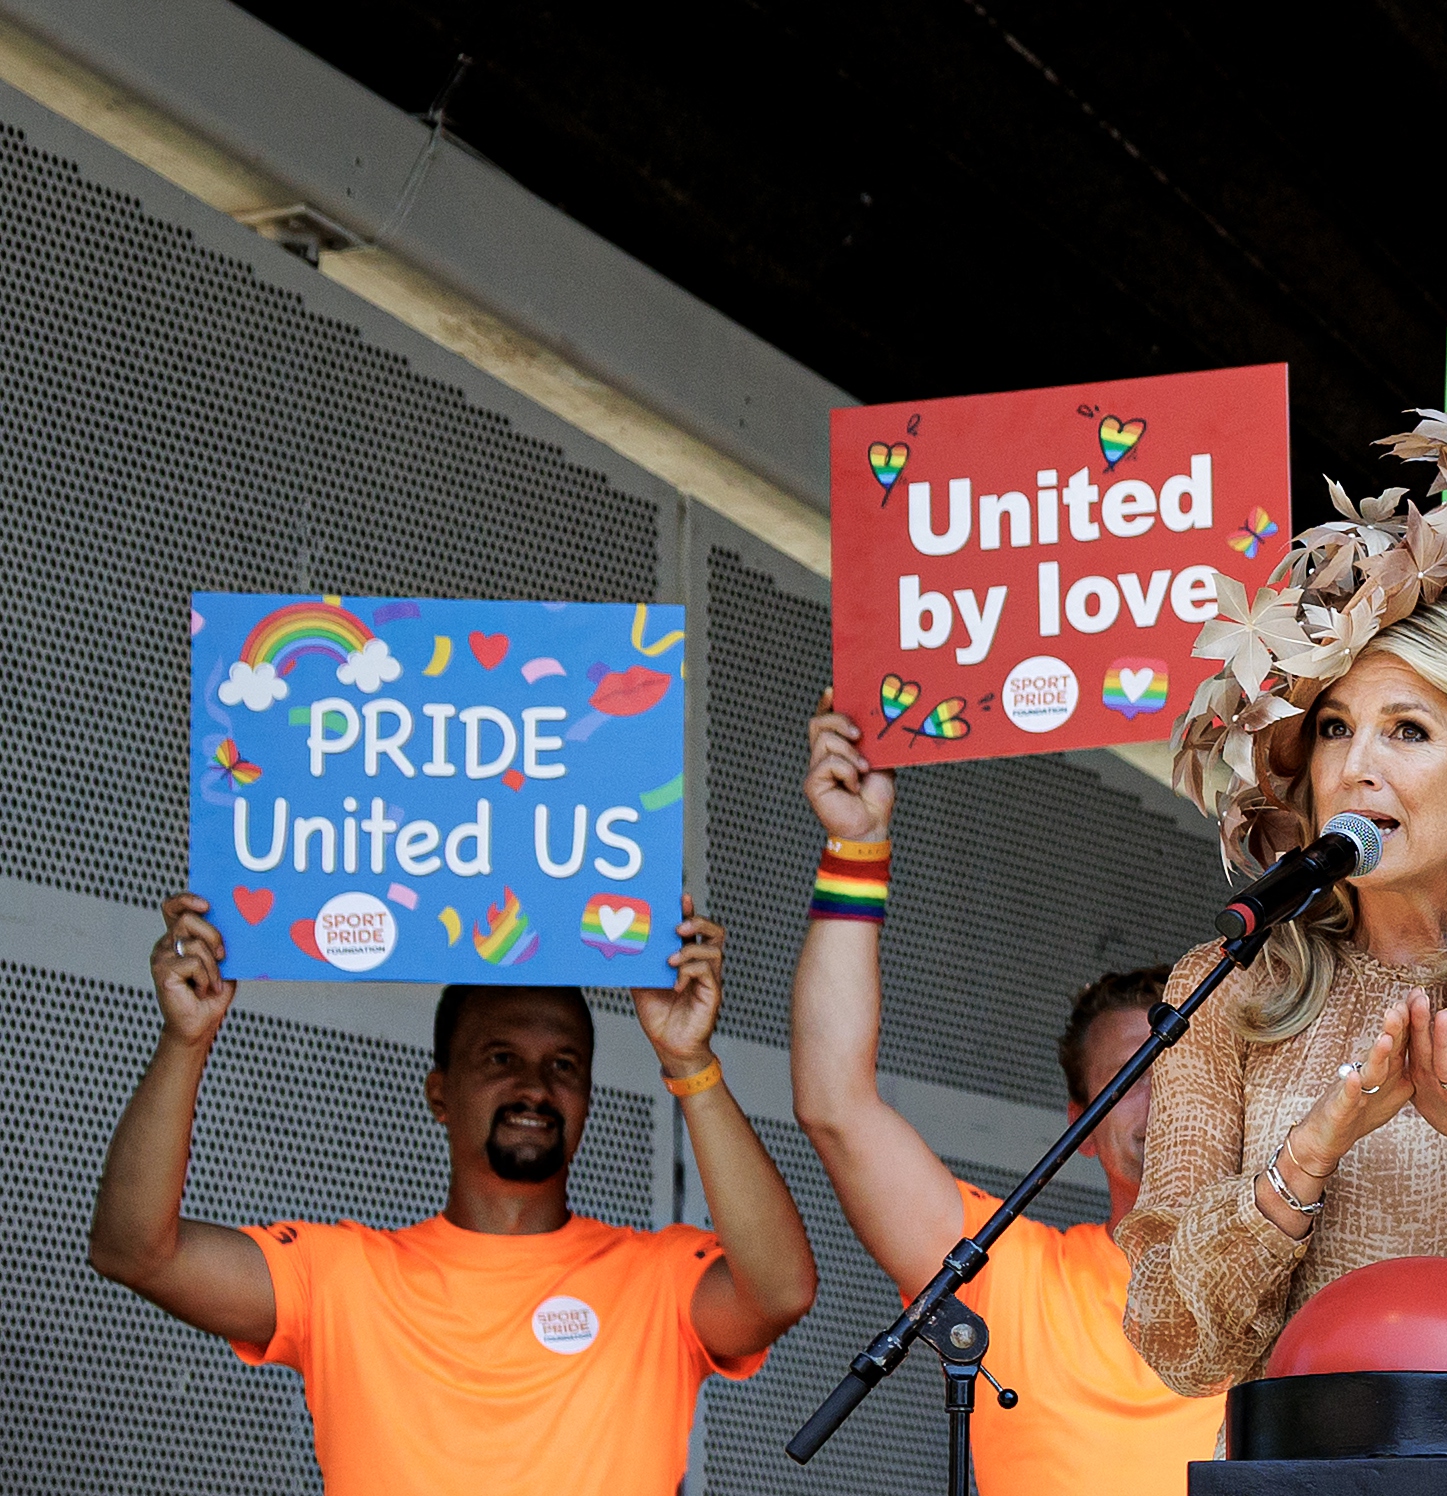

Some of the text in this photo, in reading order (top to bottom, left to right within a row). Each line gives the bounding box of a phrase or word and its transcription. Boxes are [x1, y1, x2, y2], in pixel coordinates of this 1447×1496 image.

[907, 453, 1213, 556] United
[899, 561, 1219, 665] by love
[1010, 674, 1070, 692] SPORT
[1013, 690, 1066, 707] PRIDE
[307, 698, 567, 779] PRIDE
[234, 797, 643, 880] United US
[322, 911, 387, 930] SPORT
[326, 928, 385, 944] PRIDE
[538, 1308, 589, 1324] SPORT
[542, 1322, 590, 1335] PRIDE
